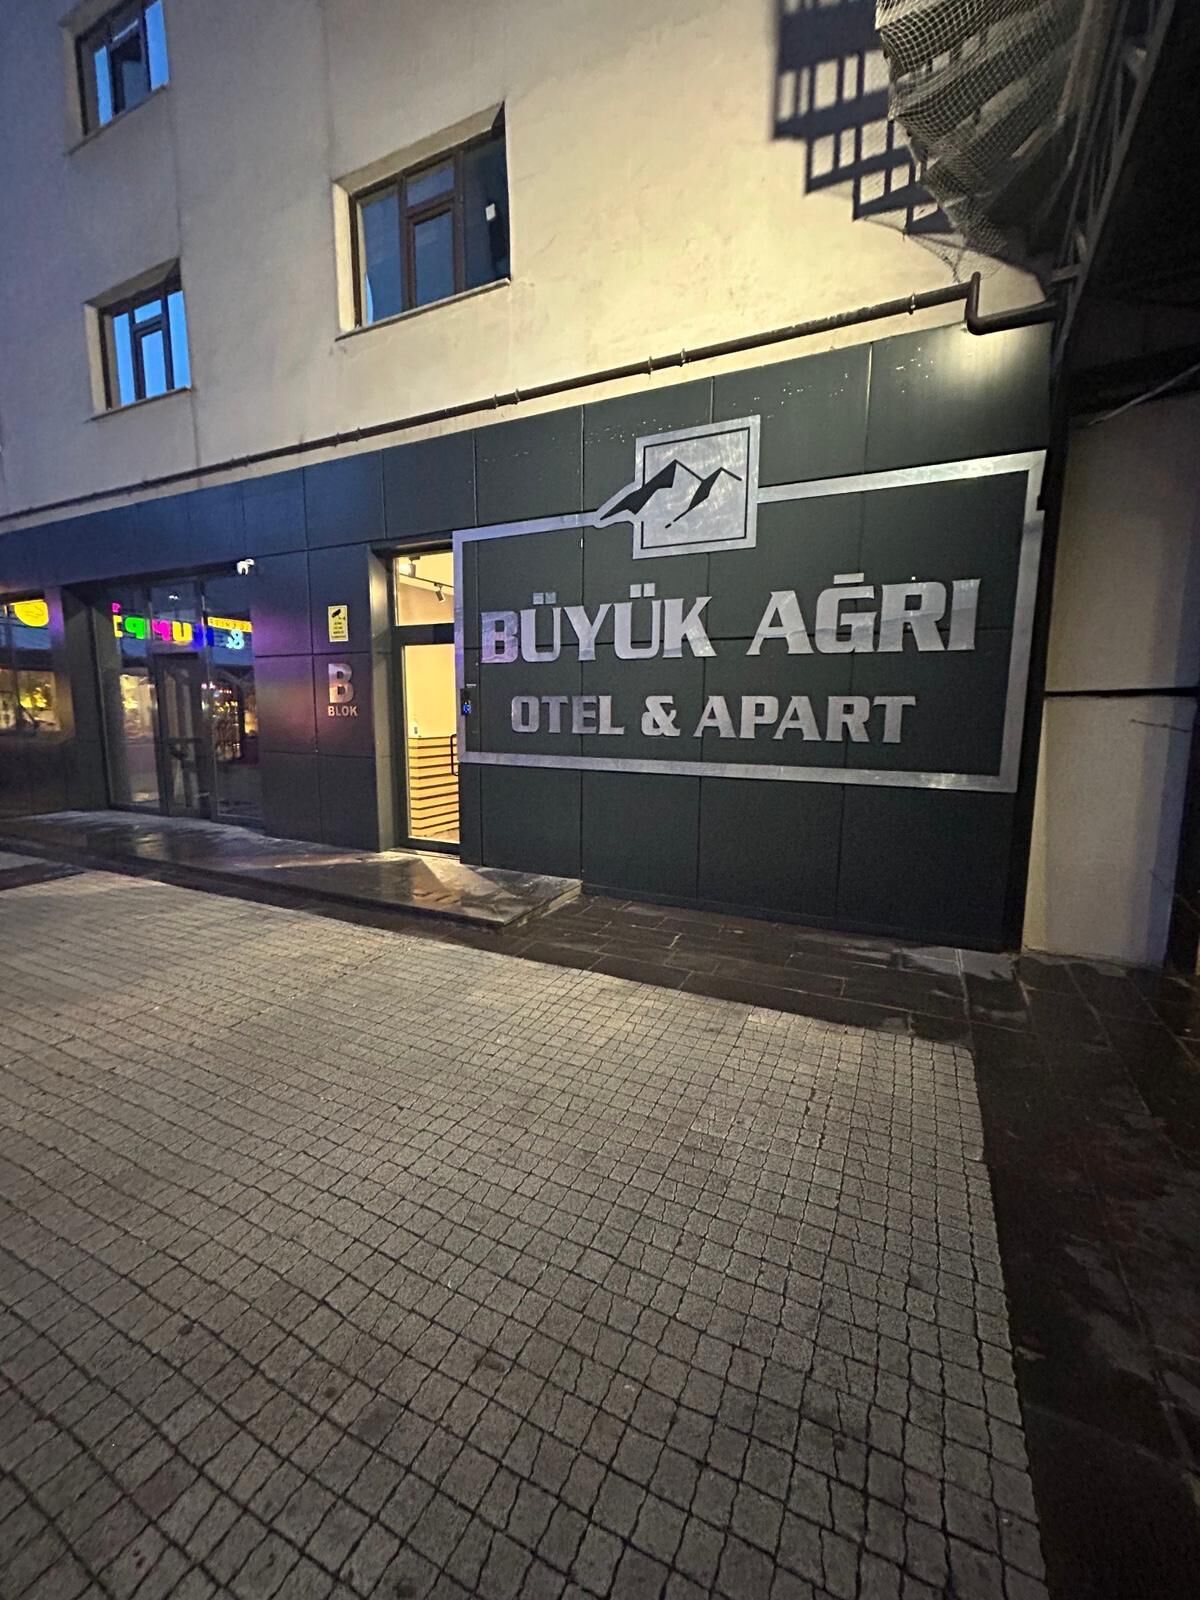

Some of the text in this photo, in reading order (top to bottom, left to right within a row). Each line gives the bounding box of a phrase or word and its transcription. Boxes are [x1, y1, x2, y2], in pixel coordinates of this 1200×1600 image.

[481, 573, 981, 663] BÜYÜK AĞRI
[328, 663, 354, 703] B
[328, 705, 358, 717] BLOK
[511, 695, 917, 743] OTEL & APART
